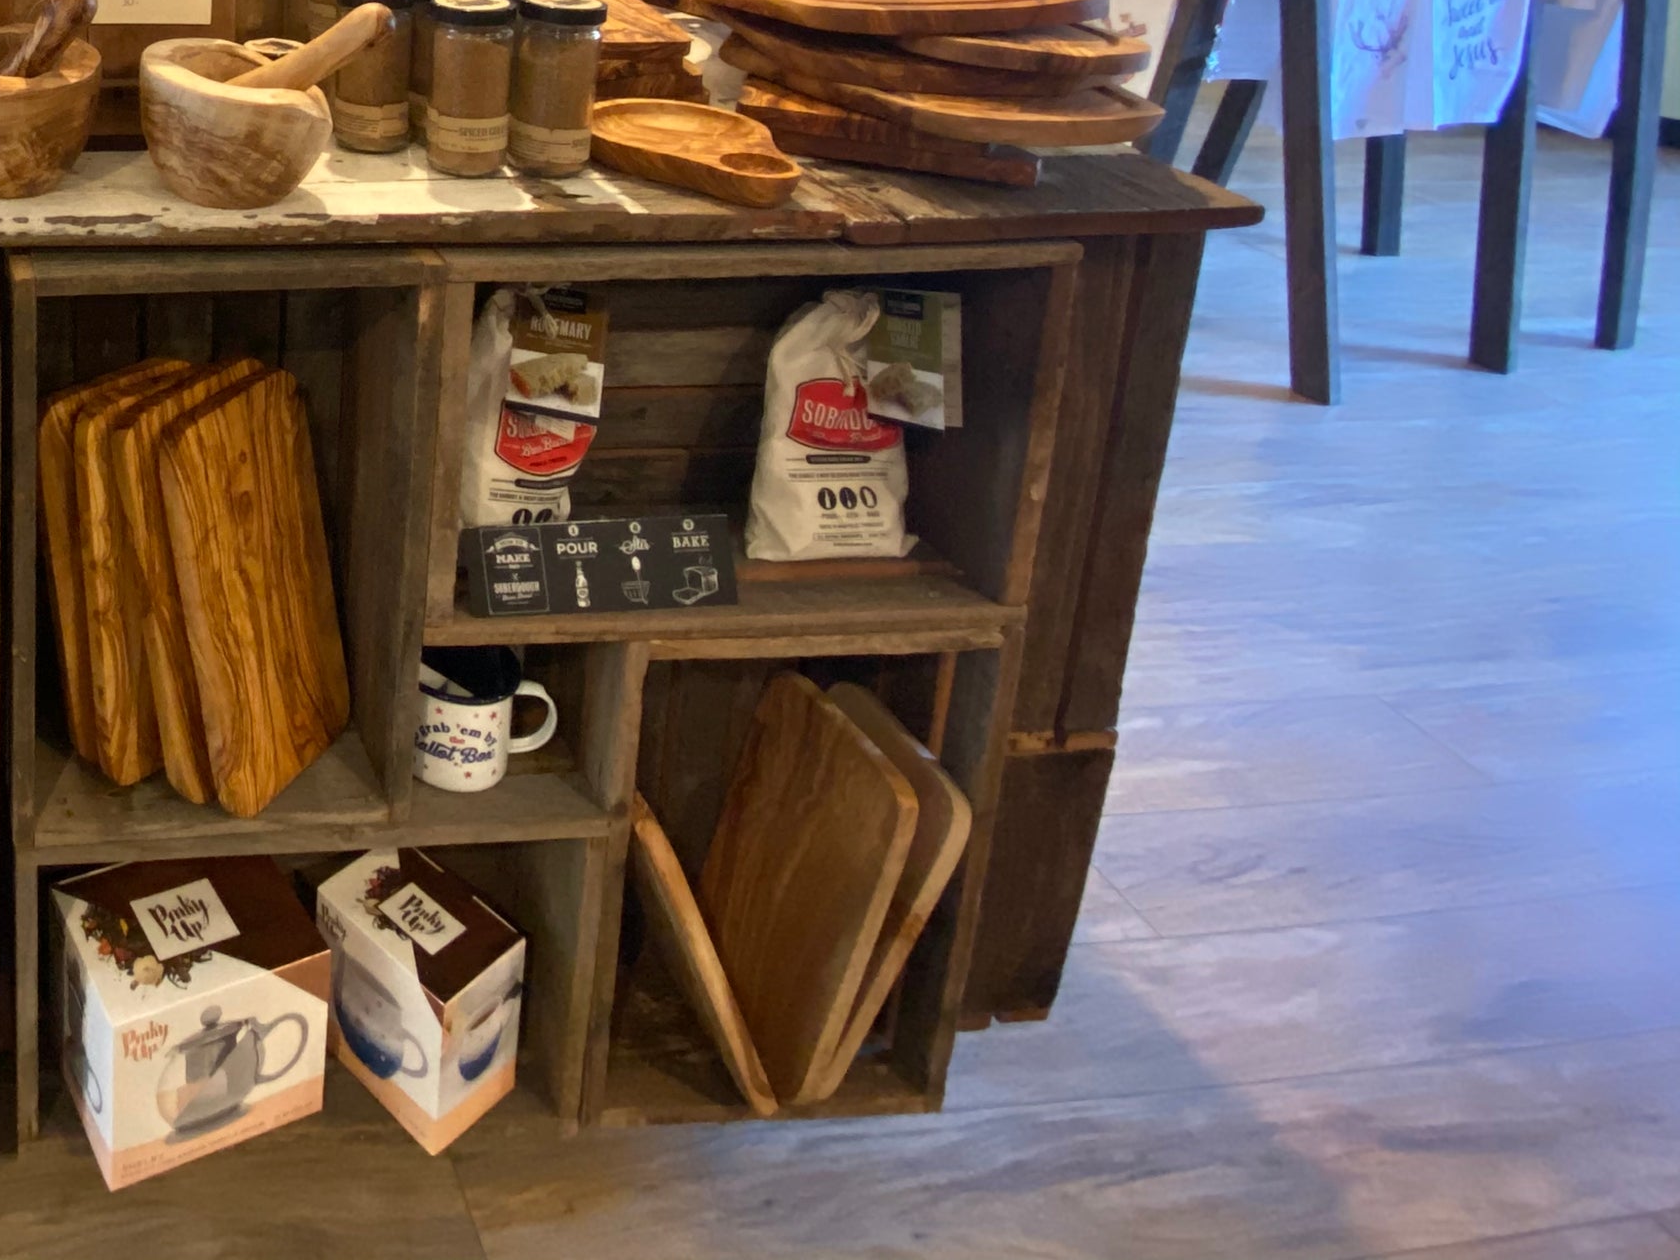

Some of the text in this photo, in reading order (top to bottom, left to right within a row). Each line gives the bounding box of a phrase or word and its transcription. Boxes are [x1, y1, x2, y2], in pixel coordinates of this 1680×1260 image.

[530, 315, 594, 341] ROEMARY
[556, 541, 598, 556] POUR
[619, 535, 651, 555] Stir
[672, 535, 710, 548] BAKE
[495, 553, 531, 565] MAKE
[419, 722, 451, 737] grab
[483, 731, 497, 747] by
[449, 736, 466, 744] the
[460, 747, 495, 763] Box
[147, 895, 210, 939] Pinky
[399, 893, 446, 935] Pinky
[170, 919, 205, 942] Up
[122, 1020, 169, 1060] Pinky
[130, 1042, 159, 1062] Up
